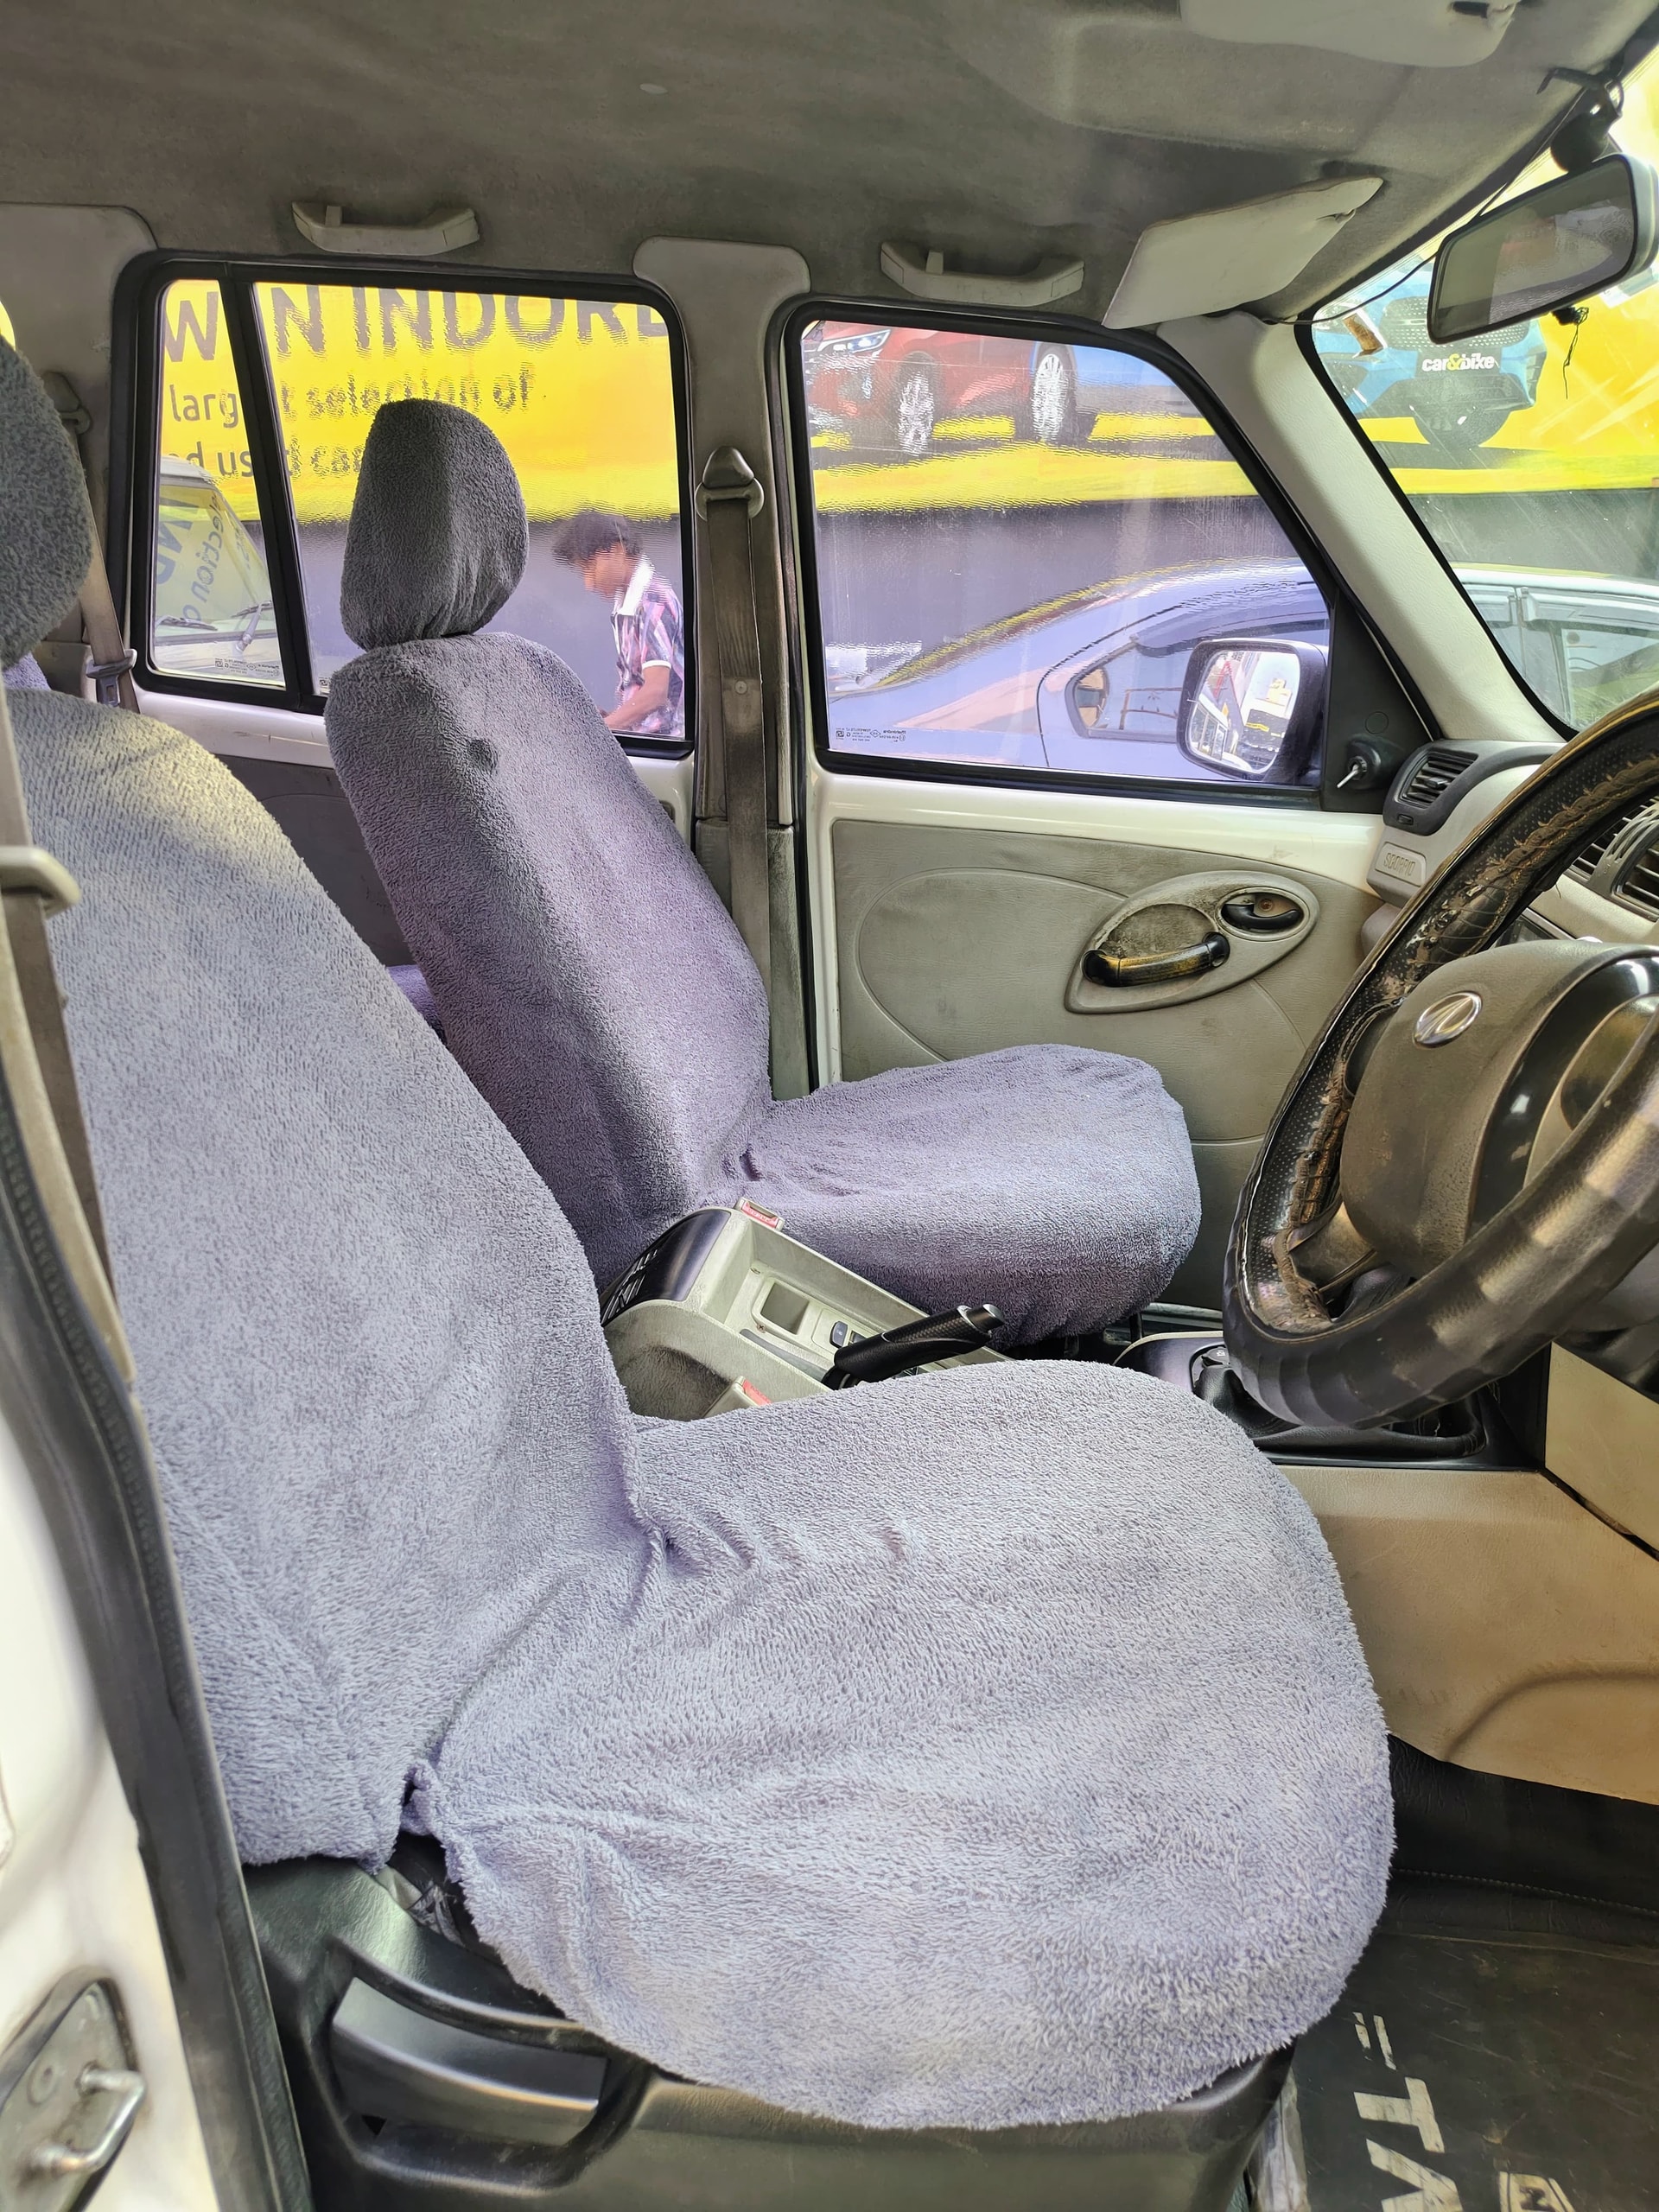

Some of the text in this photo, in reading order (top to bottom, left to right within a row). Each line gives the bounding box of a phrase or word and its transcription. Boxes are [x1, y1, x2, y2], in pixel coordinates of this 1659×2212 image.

[1421, 353, 1495, 372] car&bike
[169, 384, 298, 429] largt
[217, 435, 302, 479] usd
